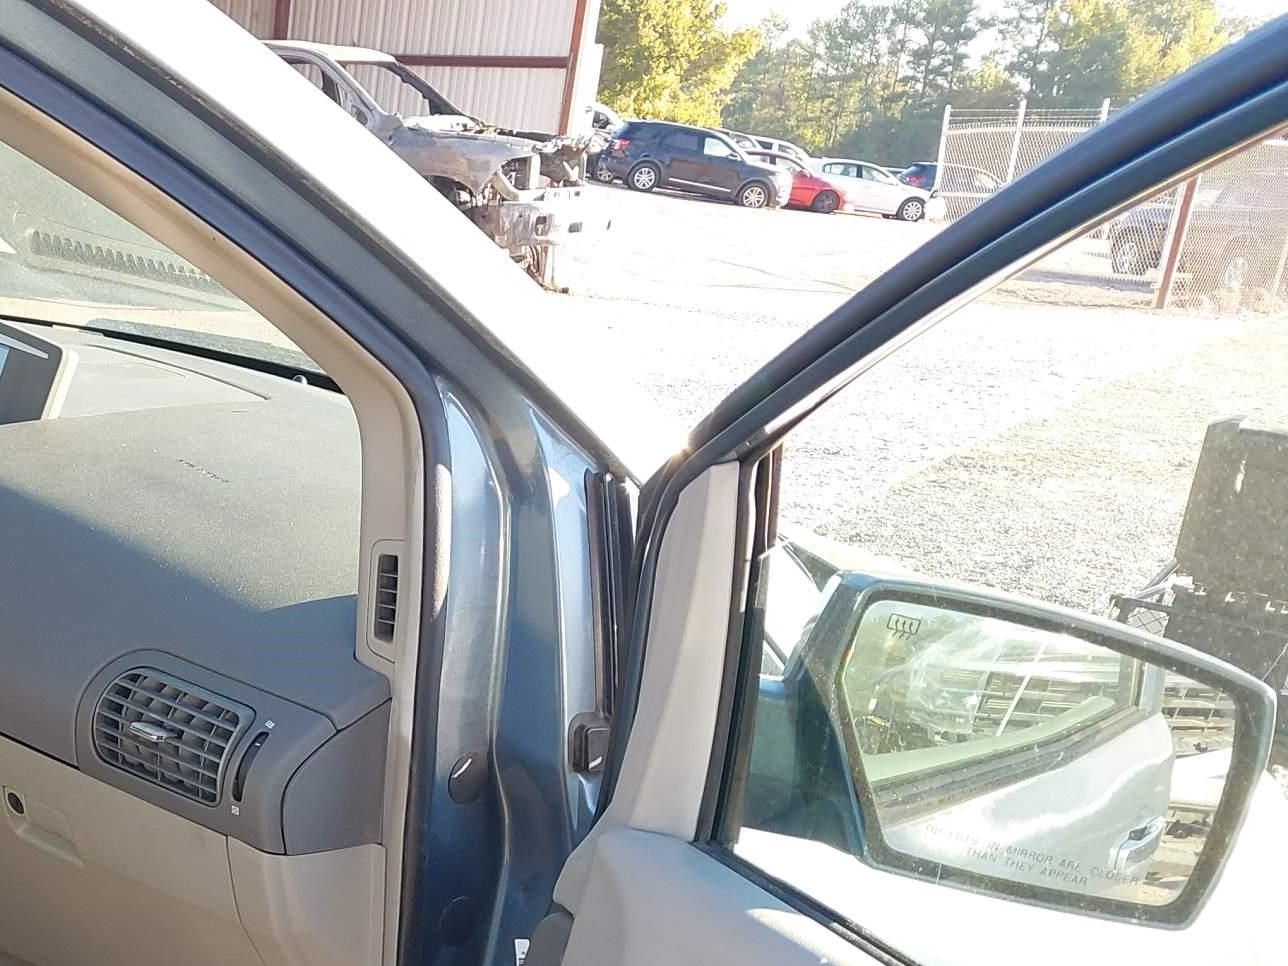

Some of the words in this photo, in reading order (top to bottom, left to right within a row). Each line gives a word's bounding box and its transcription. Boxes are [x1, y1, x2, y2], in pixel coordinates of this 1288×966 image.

[967, 847, 998, 862] THAN
[1005, 856, 1035, 872] THEY
[1040, 867, 1088, 886] APPEAR
[988, 840, 1001, 852] IN
[1006, 845, 1053, 864] MIRROR
[1058, 859, 1081, 873] ARE
